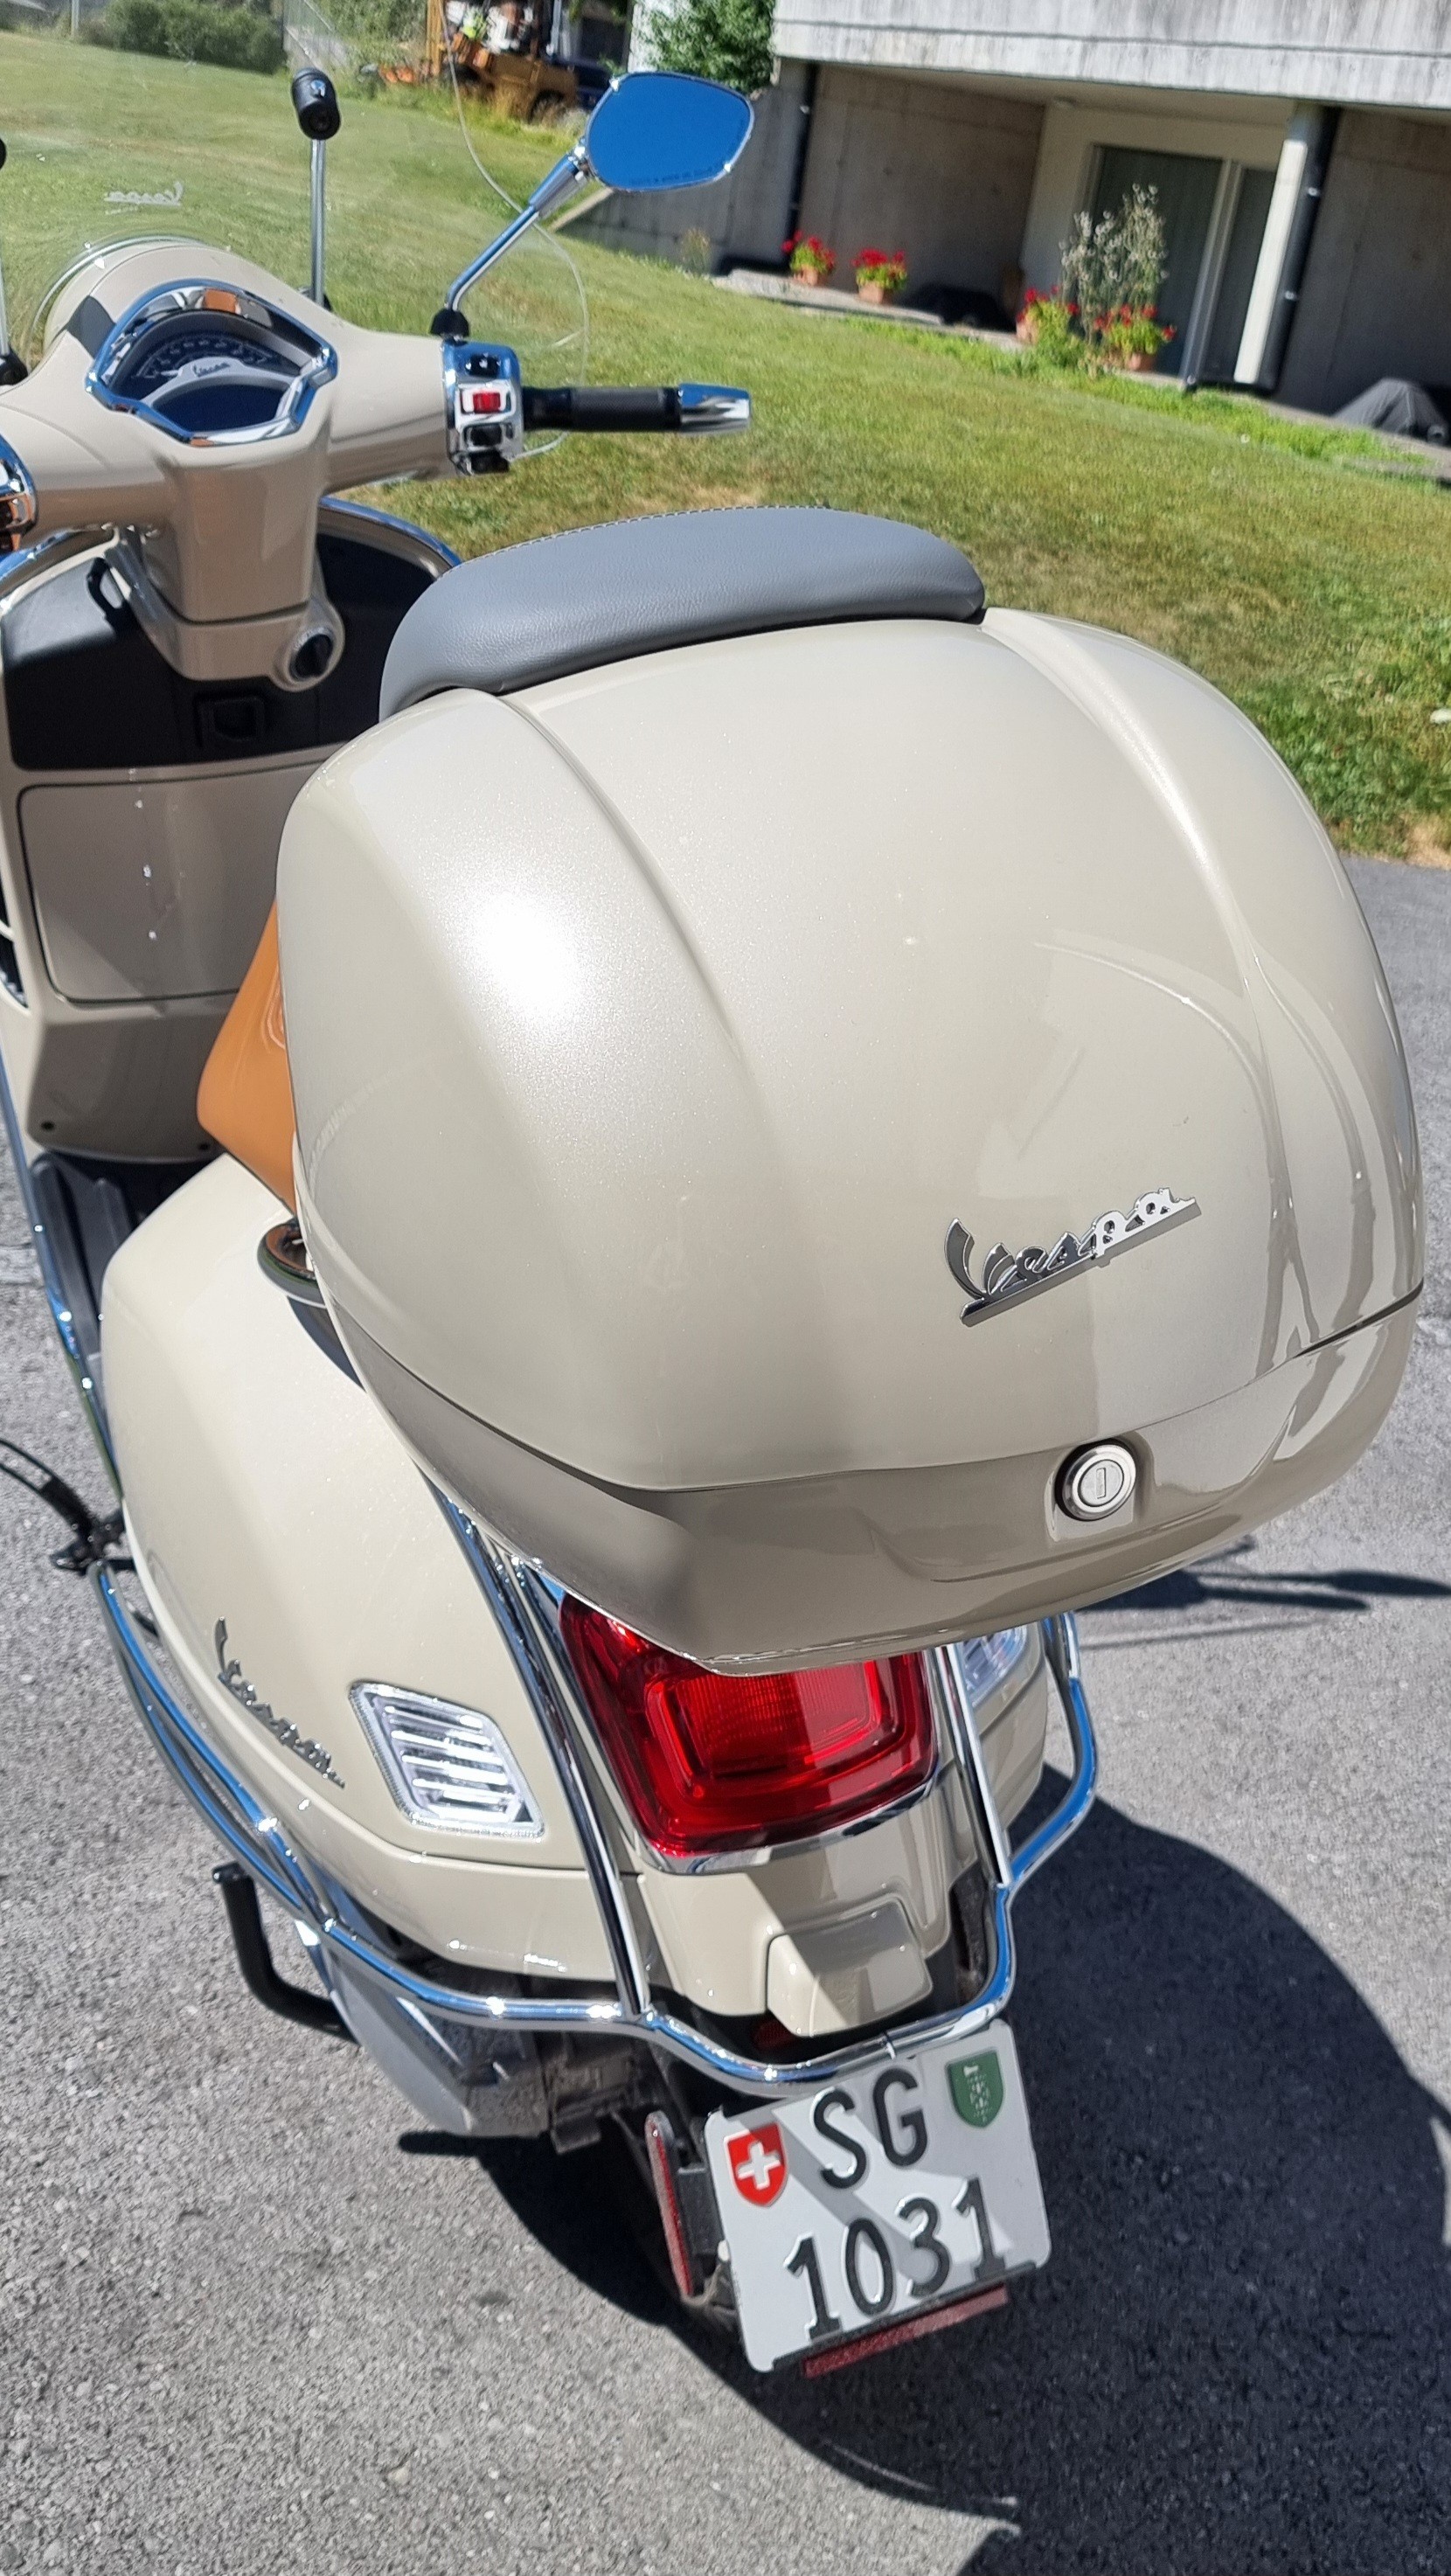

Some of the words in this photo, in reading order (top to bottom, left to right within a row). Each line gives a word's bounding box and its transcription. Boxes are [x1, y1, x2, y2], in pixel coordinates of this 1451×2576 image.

[944, 1187, 1201, 1327] Vespa
[214, 1616, 345, 1789] Vespa
[812, 2067, 928, 2189] SG
[786, 2177, 1006, 2340] 1031
